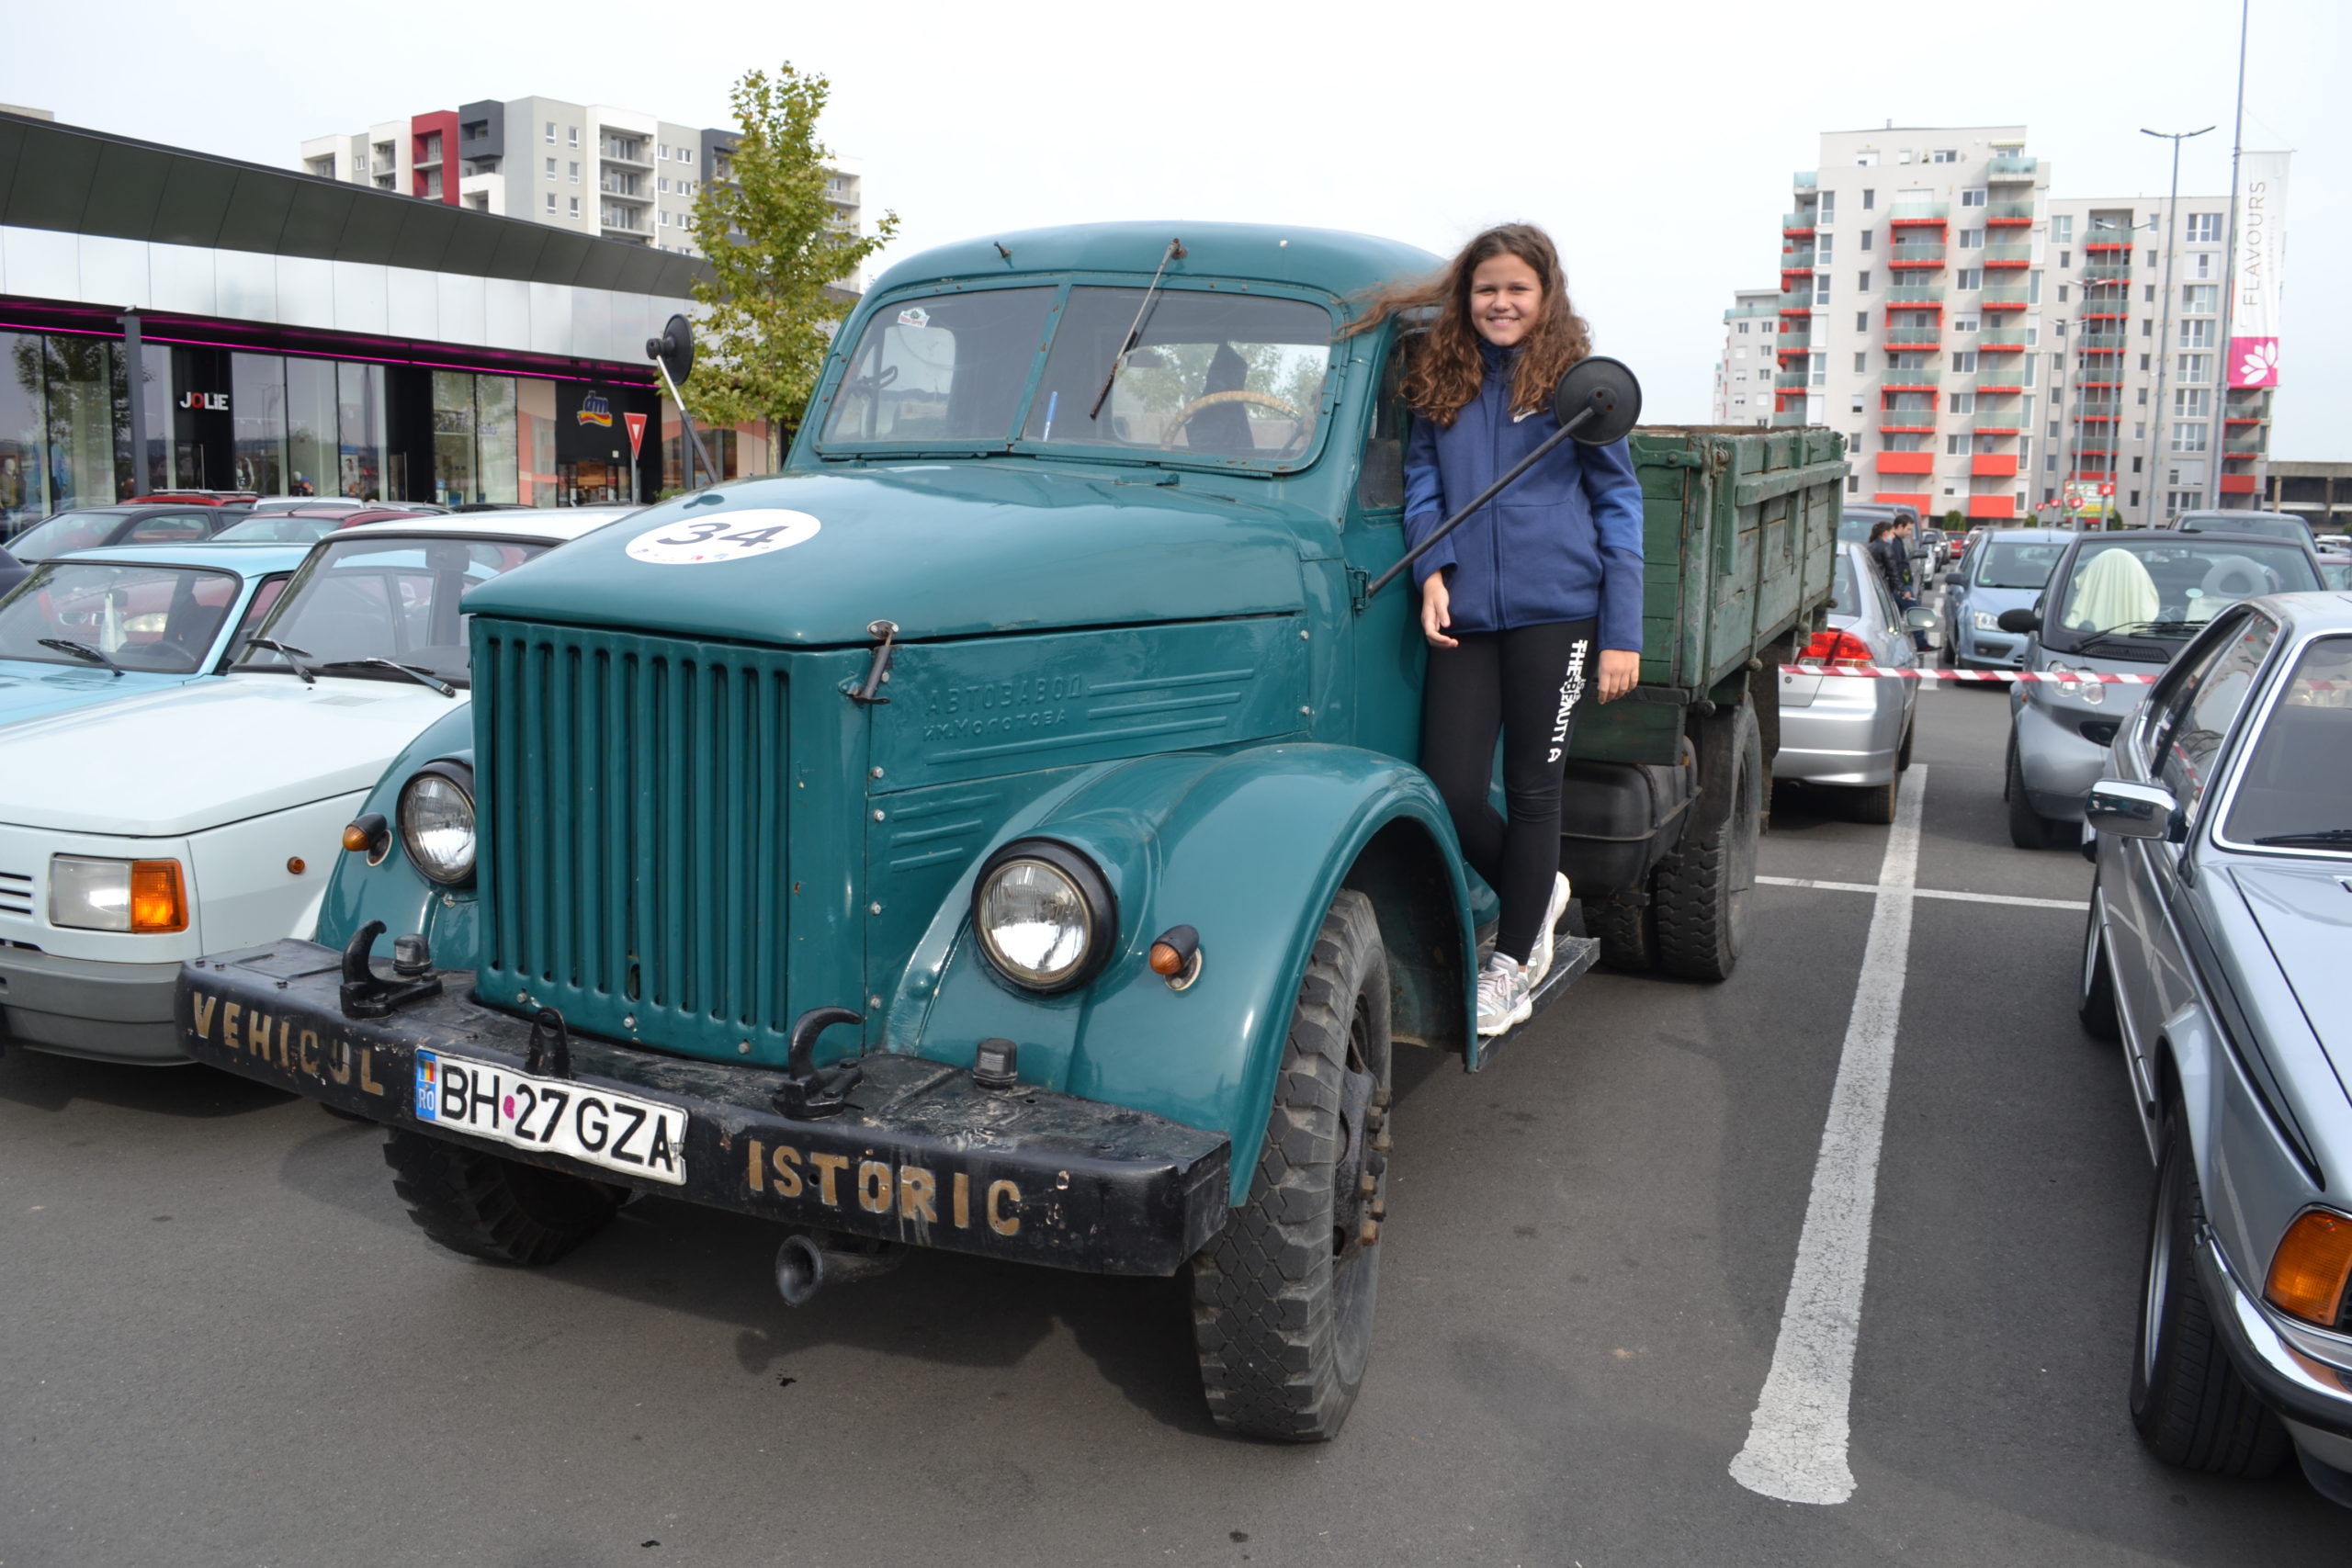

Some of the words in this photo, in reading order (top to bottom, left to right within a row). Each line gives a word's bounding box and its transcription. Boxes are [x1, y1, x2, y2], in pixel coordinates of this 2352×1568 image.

[2243, 181, 2267, 306] FLAVOURS
[179, 391, 229, 411] JOLIE
[582, 389, 609, 413] dm
[656, 522, 790, 547] 34
[1566, 639, 1589, 676] THE
[191, 991, 384, 1096] VEHICUL
[418, 1088, 435, 1111] RO
[441, 1064, 500, 1129] BH
[514, 1083, 570, 1143] 27
[576, 1097, 673, 1172] GZA
[749, 1140, 1022, 1235] ISTORIC
